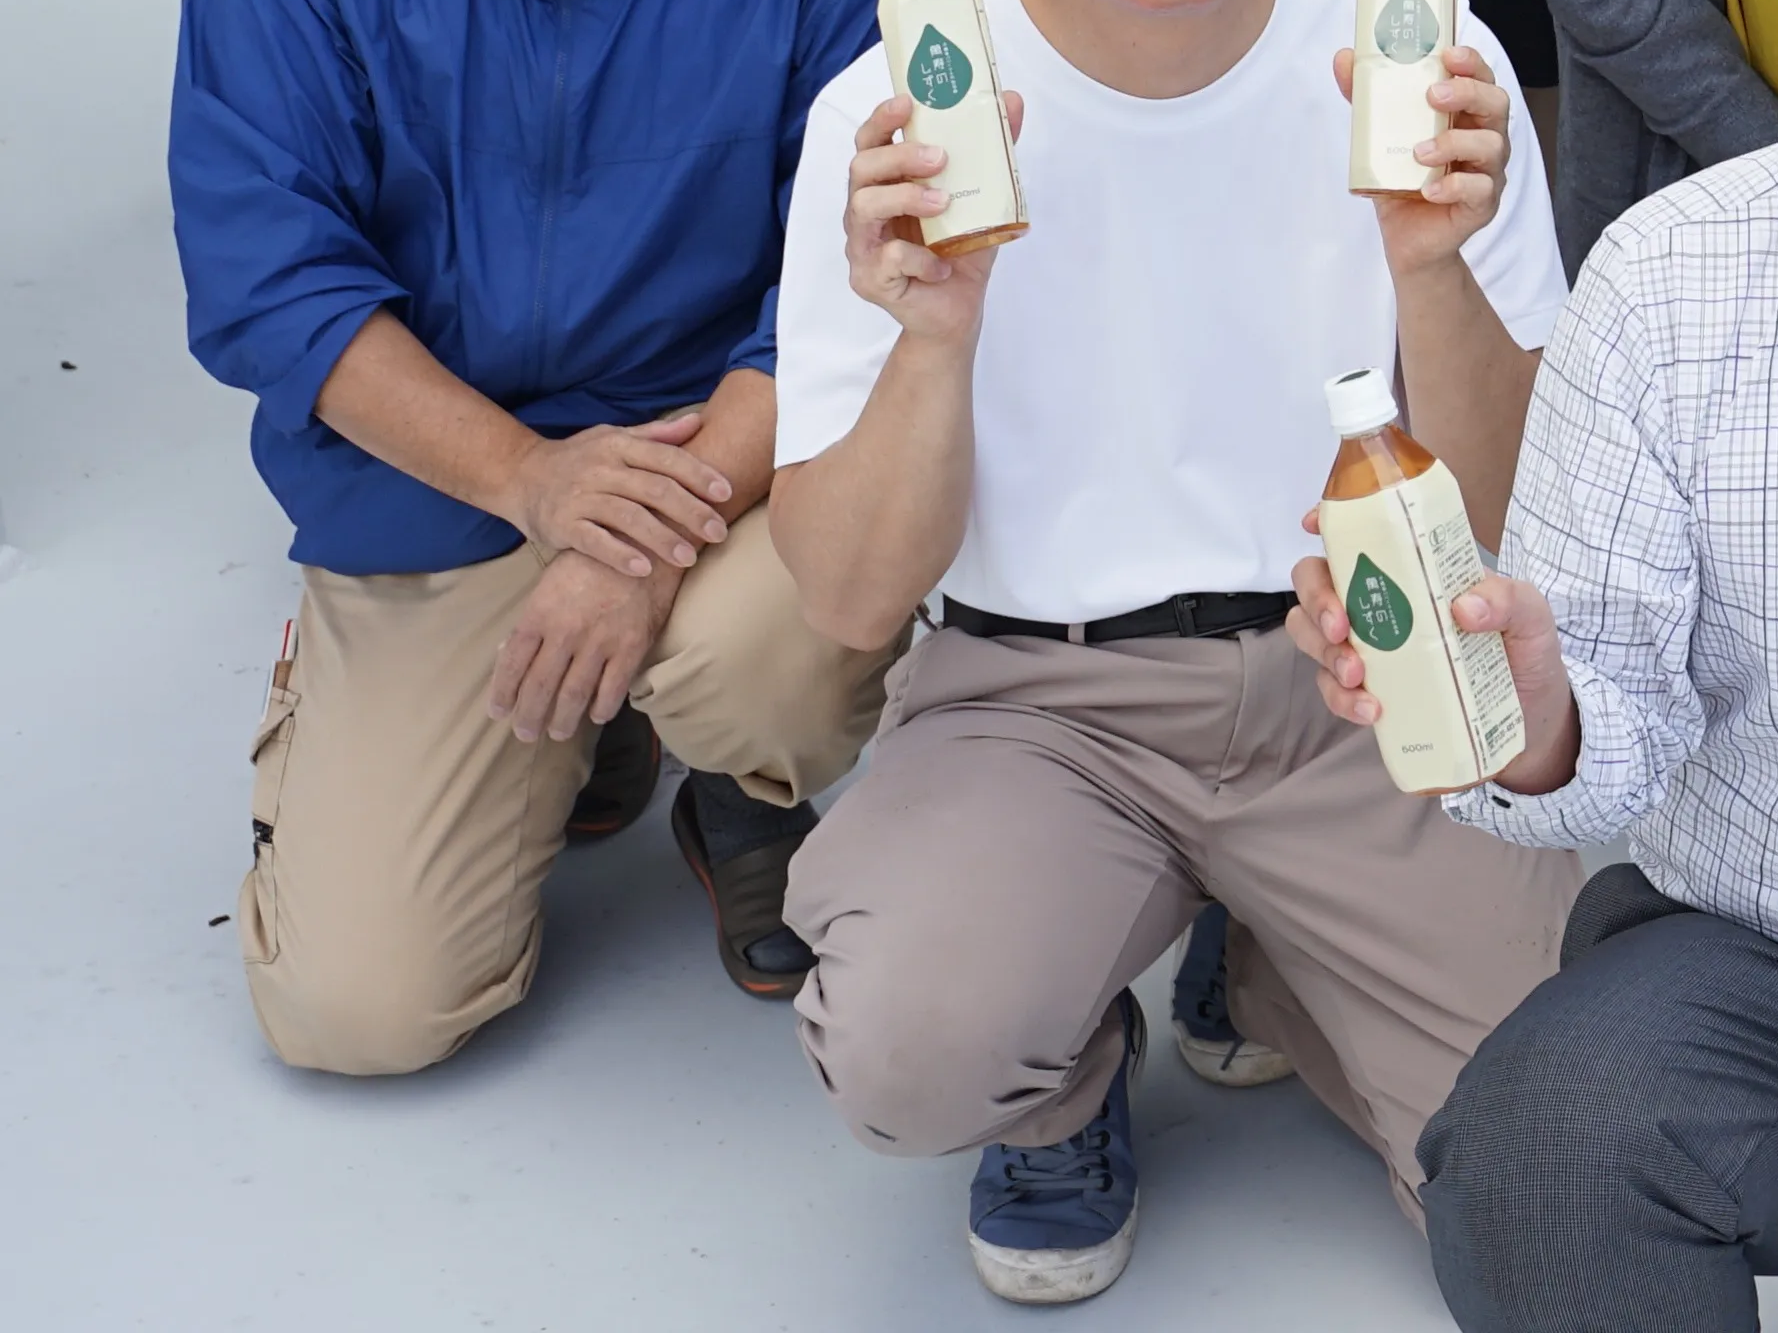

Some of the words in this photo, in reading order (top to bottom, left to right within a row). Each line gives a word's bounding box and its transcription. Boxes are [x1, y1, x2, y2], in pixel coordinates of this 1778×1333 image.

[920, 63, 937, 102] しずく
[1359, 596, 1379, 641] しずく
